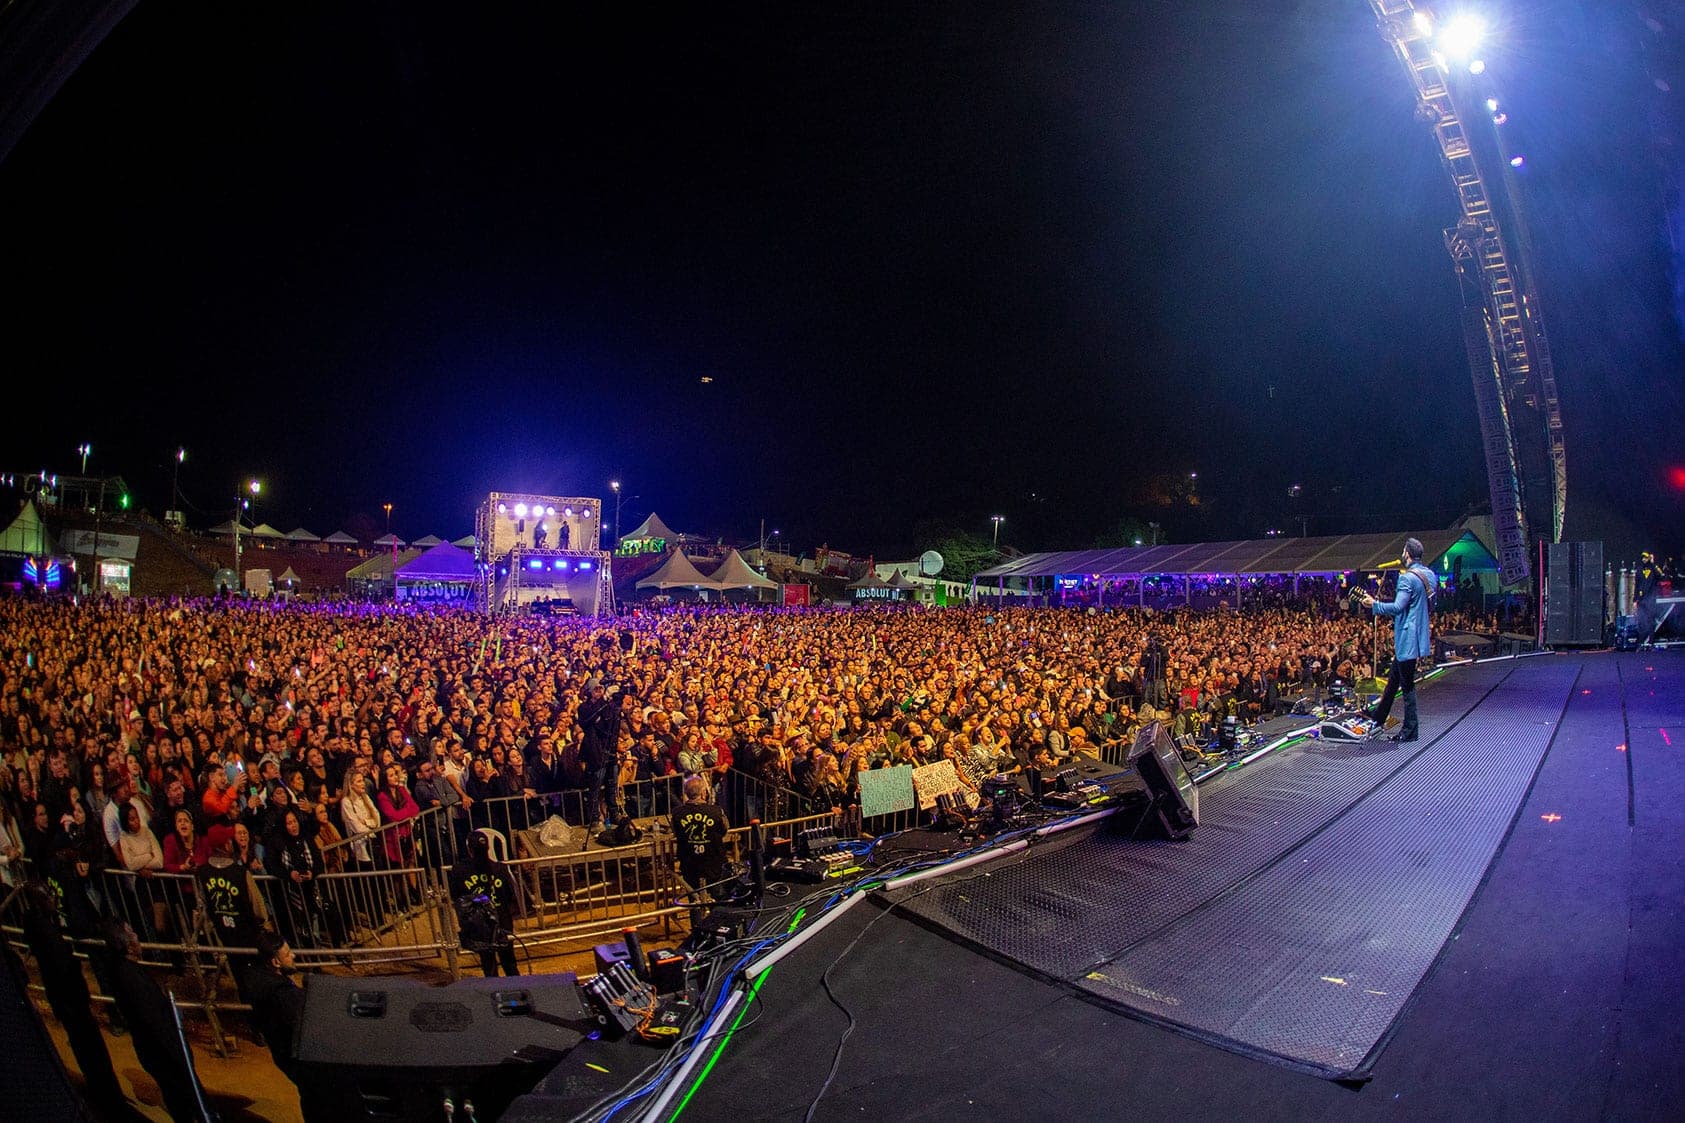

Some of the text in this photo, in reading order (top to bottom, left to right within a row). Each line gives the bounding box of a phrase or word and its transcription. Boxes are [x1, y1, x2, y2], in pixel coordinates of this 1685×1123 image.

[411, 584, 466, 597] ABSOLUT
[855, 588, 890, 598] ABSOLUT
[680, 812, 715, 827] APOIO
[693, 844, 705, 855] 20
[206, 877, 239, 896] APOIO
